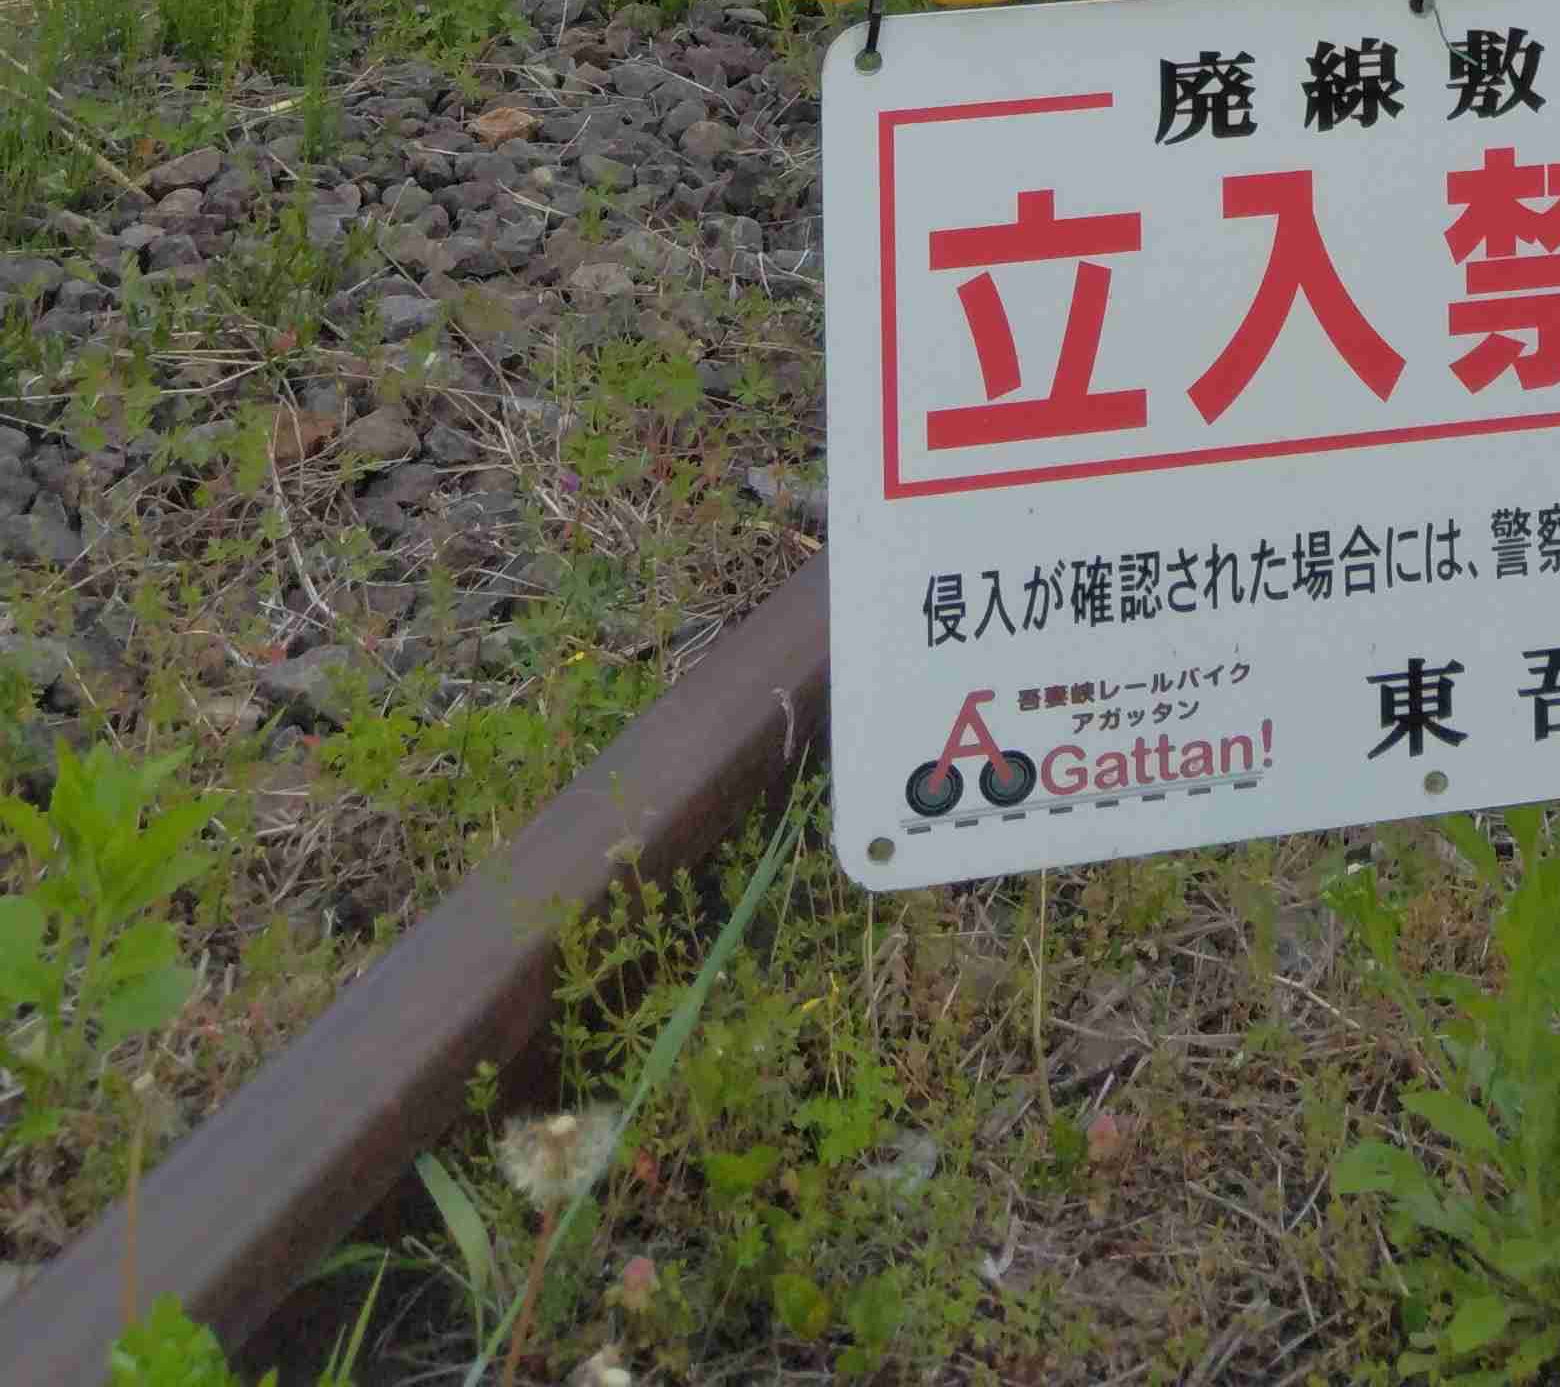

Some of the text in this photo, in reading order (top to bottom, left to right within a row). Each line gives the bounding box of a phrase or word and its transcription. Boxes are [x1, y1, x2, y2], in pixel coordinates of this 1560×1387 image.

[1071, 700, 1200, 735] アガッタン
